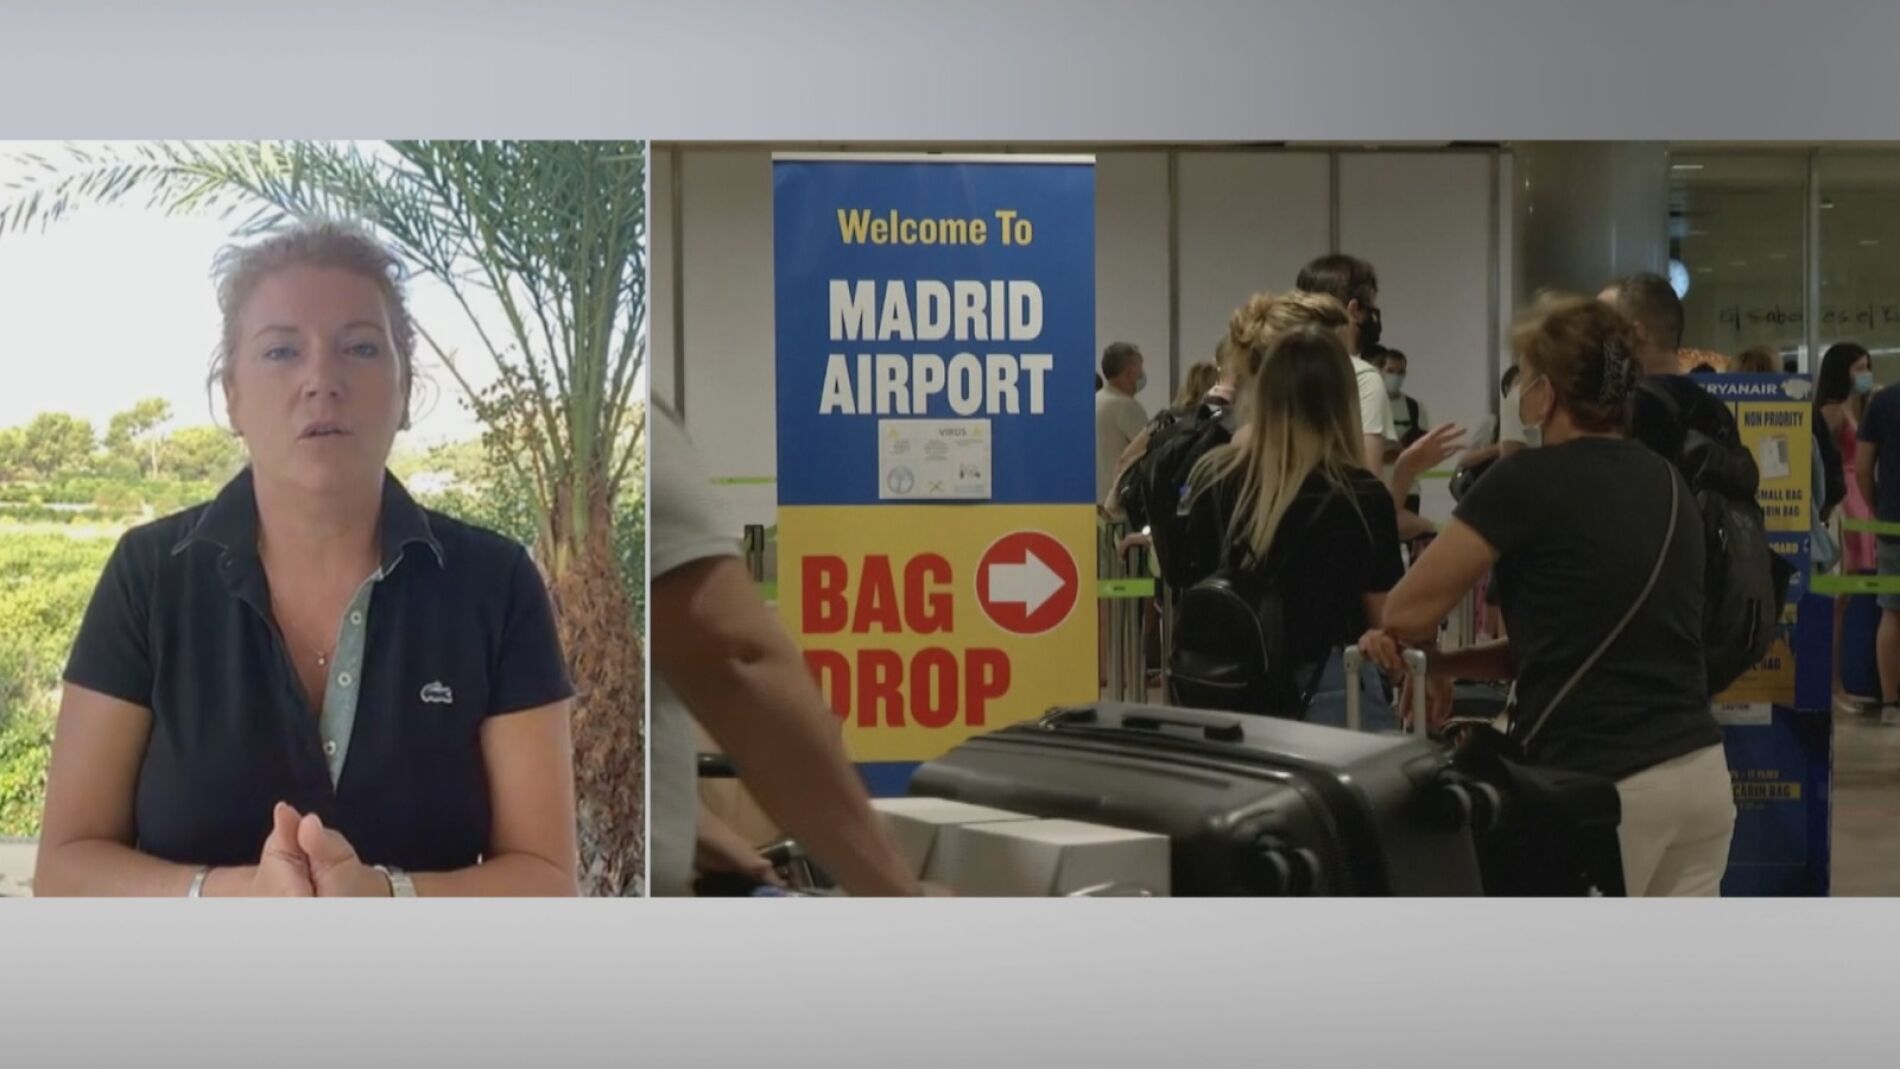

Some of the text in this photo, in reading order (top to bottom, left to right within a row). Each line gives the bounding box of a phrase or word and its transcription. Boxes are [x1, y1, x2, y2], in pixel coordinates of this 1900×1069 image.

[837, 209, 1033, 245] Welcome To
[829, 279, 1043, 341] MADRID
[819, 352, 1053, 416] AIRPORT
[1706, 383, 1777, 395] RYANAIR
[1744, 410, 1804, 427] NON PRIORITY
[939, 428, 967, 436] VIRUS
[1785, 488, 1803, 500] BAG
[801, 552, 954, 634] BAG
[803, 646, 1011, 728] DROP
[1769, 784, 1791, 797] BAG
